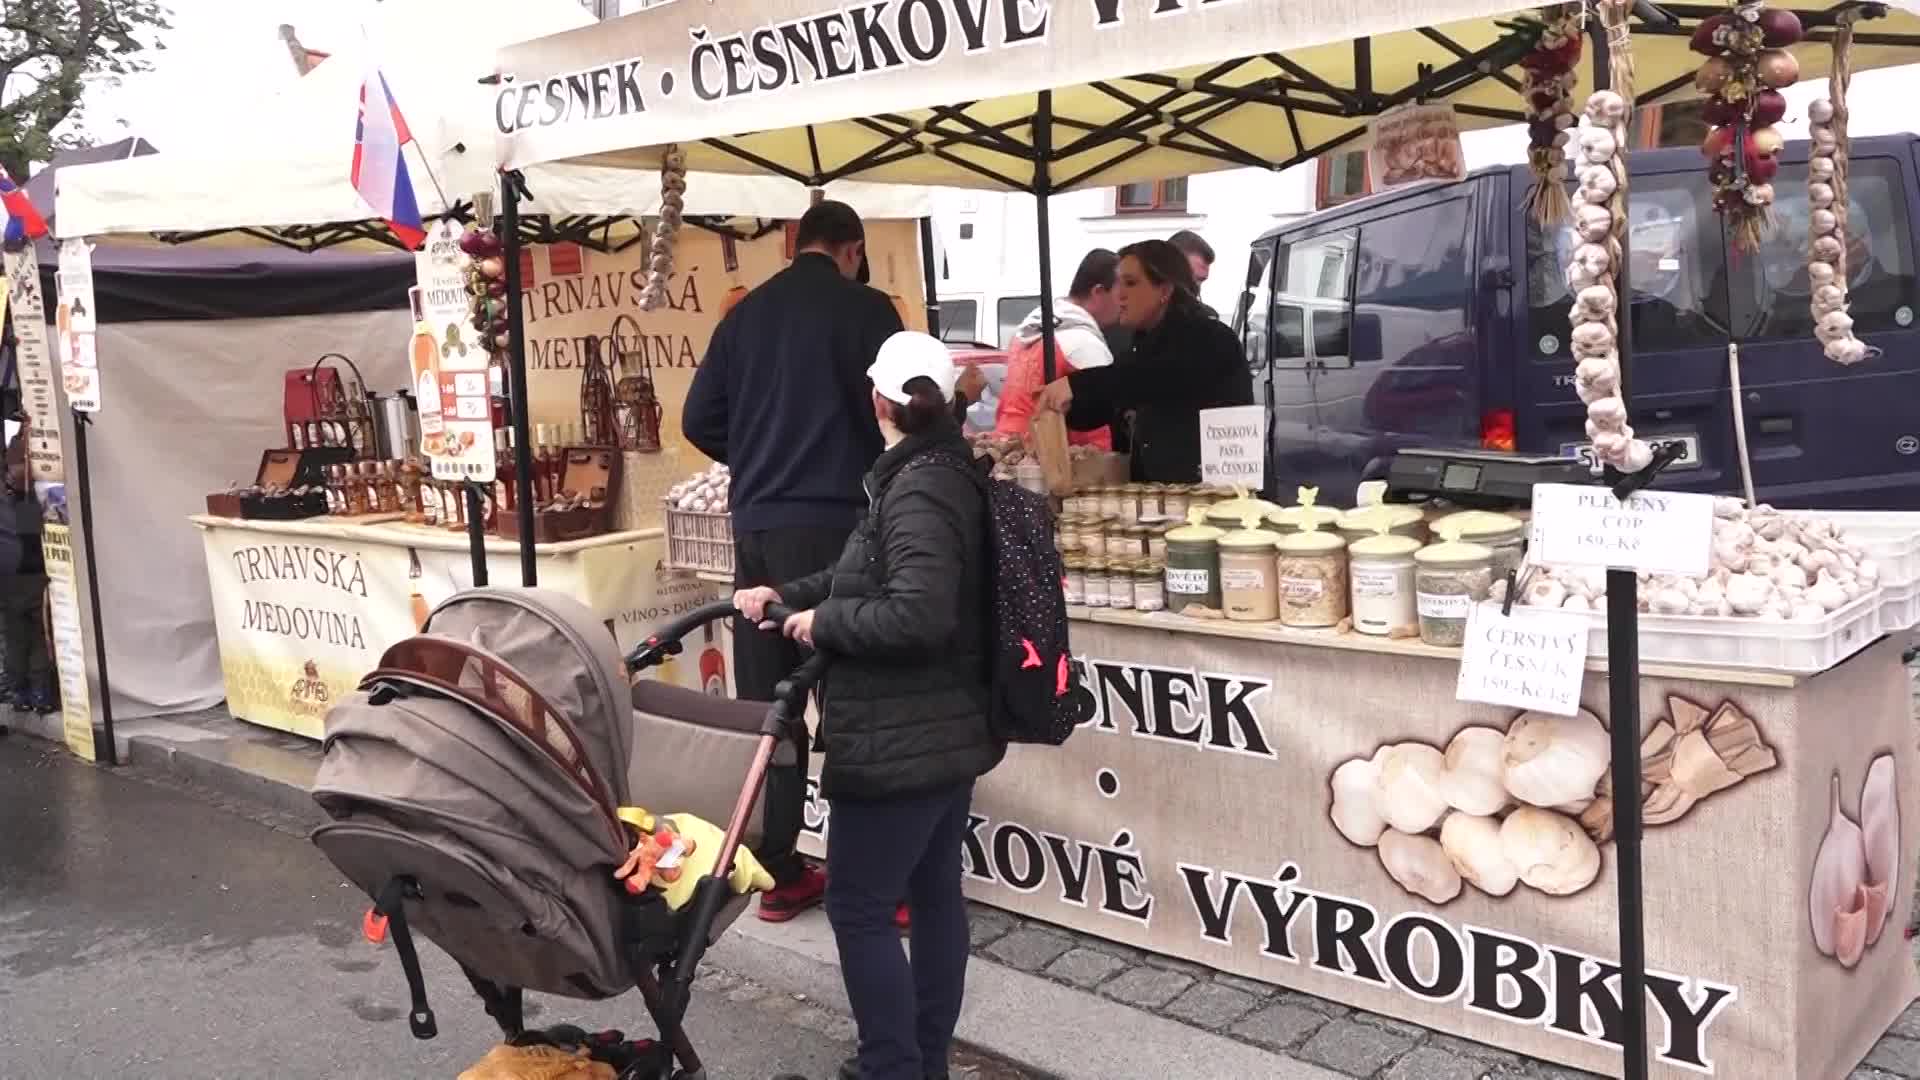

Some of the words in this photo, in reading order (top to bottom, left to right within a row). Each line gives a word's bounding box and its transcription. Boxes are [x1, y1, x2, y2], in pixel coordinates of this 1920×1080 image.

[496, 60, 646, 133] ČESNEK
[427, 288, 465, 305] MEDOVI
[530, 334, 700, 369] MEDOVINA
[233, 545, 368, 597] TRNAVSKÁ
[241, 600, 366, 650] MEDOVINA
[1182, 865, 1731, 1067] VÝROBKY
